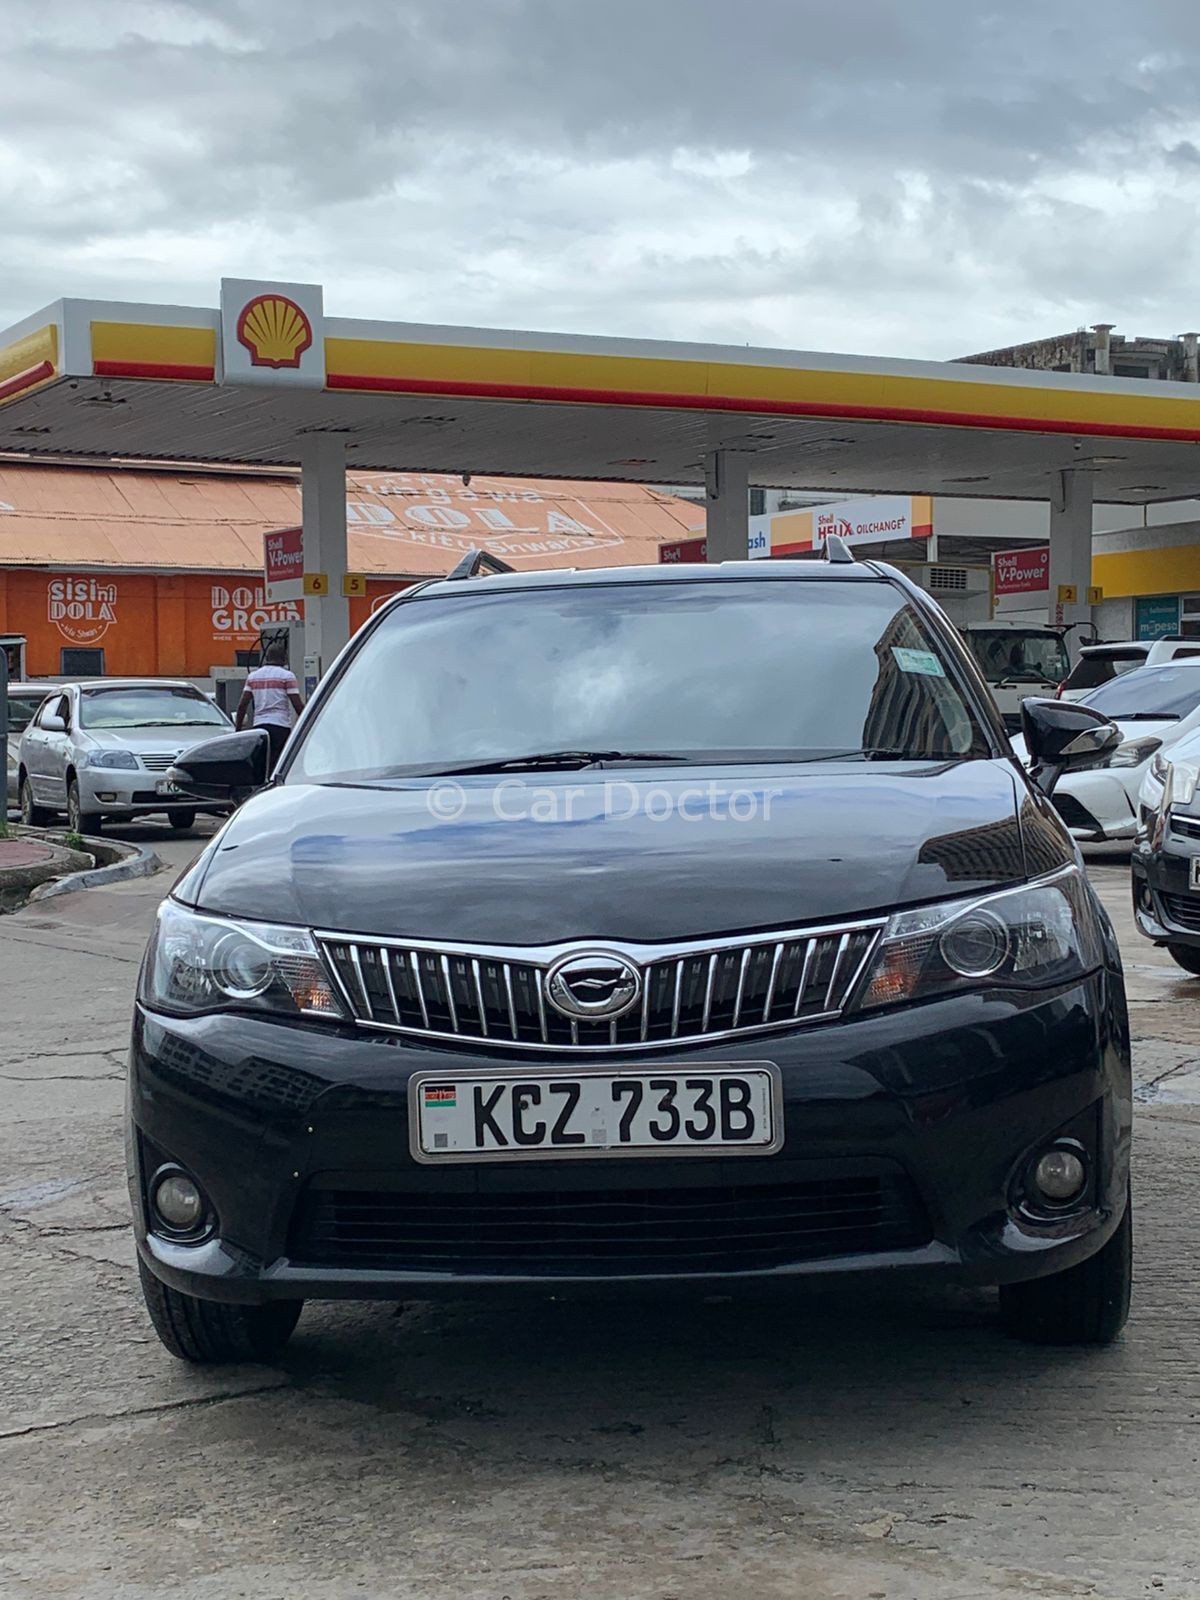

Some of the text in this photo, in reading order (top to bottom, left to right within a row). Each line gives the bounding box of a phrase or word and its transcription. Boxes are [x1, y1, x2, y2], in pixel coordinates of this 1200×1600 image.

[818, 513, 833, 525] Shell
[268, 537, 283, 551] Shell
[998, 556, 1017, 568] Shell
[998, 566, 1045, 582] V-Power
[312, 578, 321, 590] 6
[350, 579, 359, 590] 5
[1065, 589, 1072, 599] 2
[51, 601, 112, 620] DOLA
[473, 1083, 586, 1147] KCZ
[611, 1078, 755, 1142] 733B
